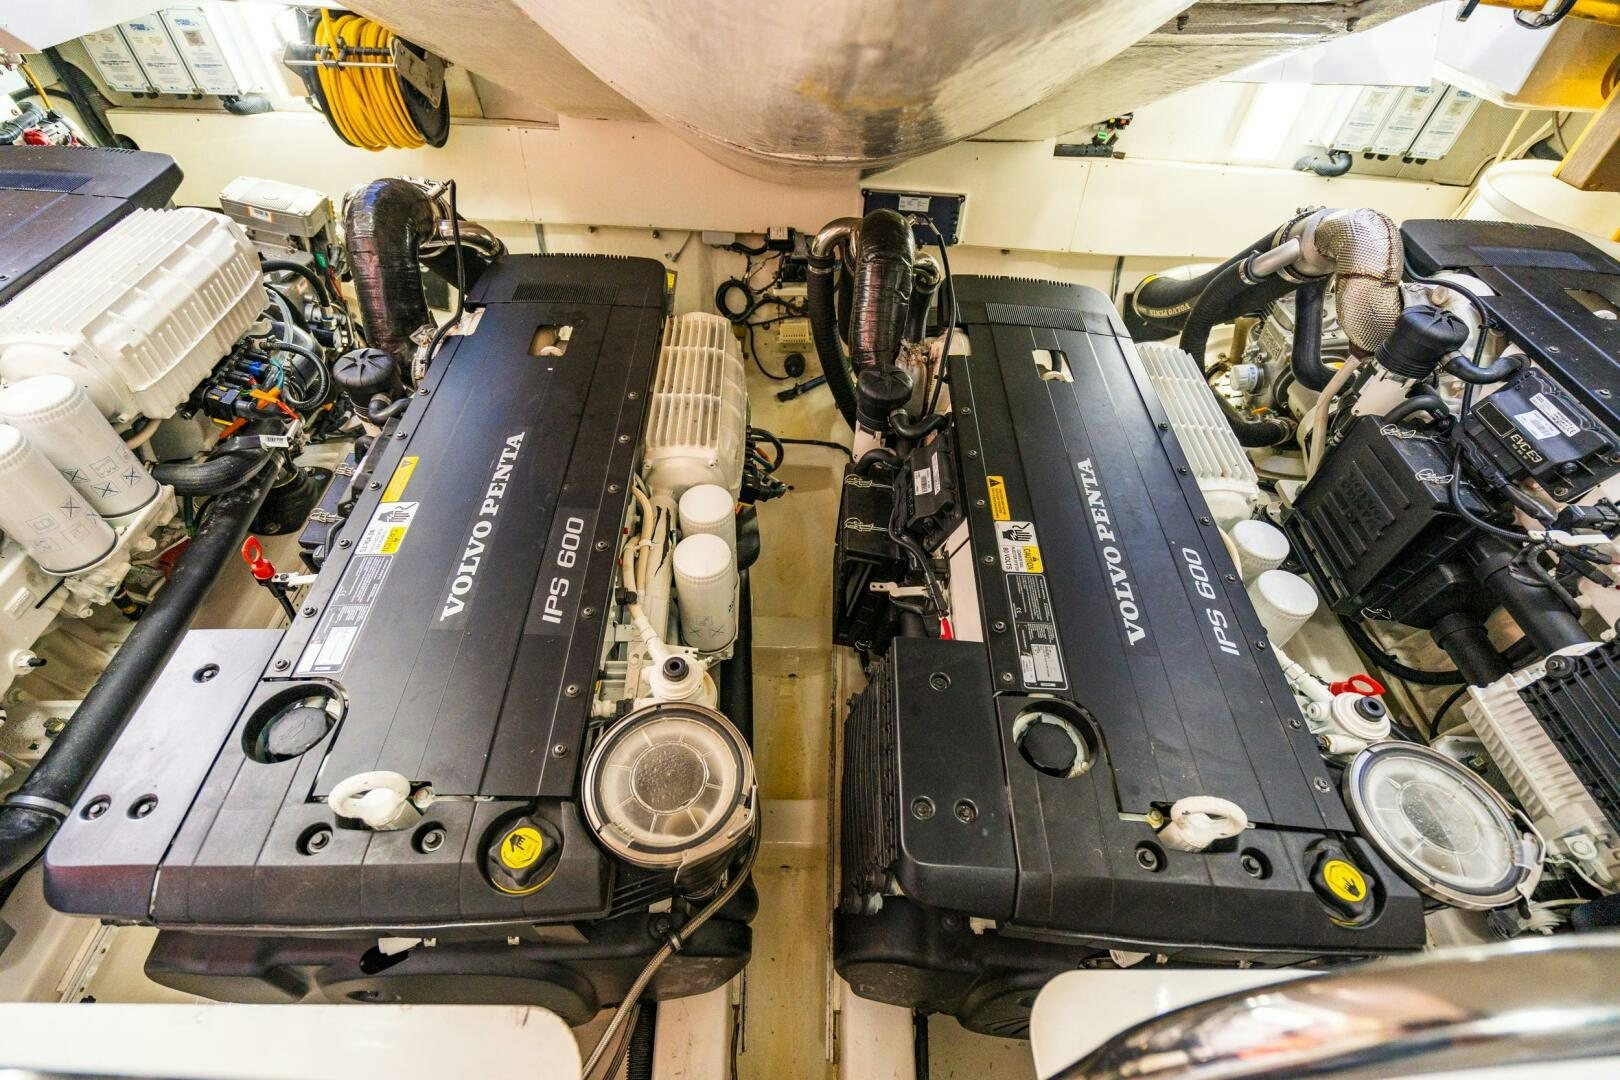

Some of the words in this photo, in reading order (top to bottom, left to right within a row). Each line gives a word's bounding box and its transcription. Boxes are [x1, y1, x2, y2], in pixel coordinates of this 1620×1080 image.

[1168, 303, 1191, 316] VOLVO
[1510, 433, 1531, 451] EVC
[1525, 449, 1543, 463] E3
[1077, 457, 1116, 542] PENTA
[440, 520, 492, 621] VOLVO
[479, 432, 525, 516] PENTA
[542, 577, 570, 624] IPS
[557, 516, 584, 568] 600
[1004, 554, 1012, 570] VOLTS
[1024, 547, 1034, 570] CAUTION
[1182, 547, 1216, 600] 600
[1103, 546, 1146, 645] VOLVO
[1206, 608, 1240, 656] IPS
